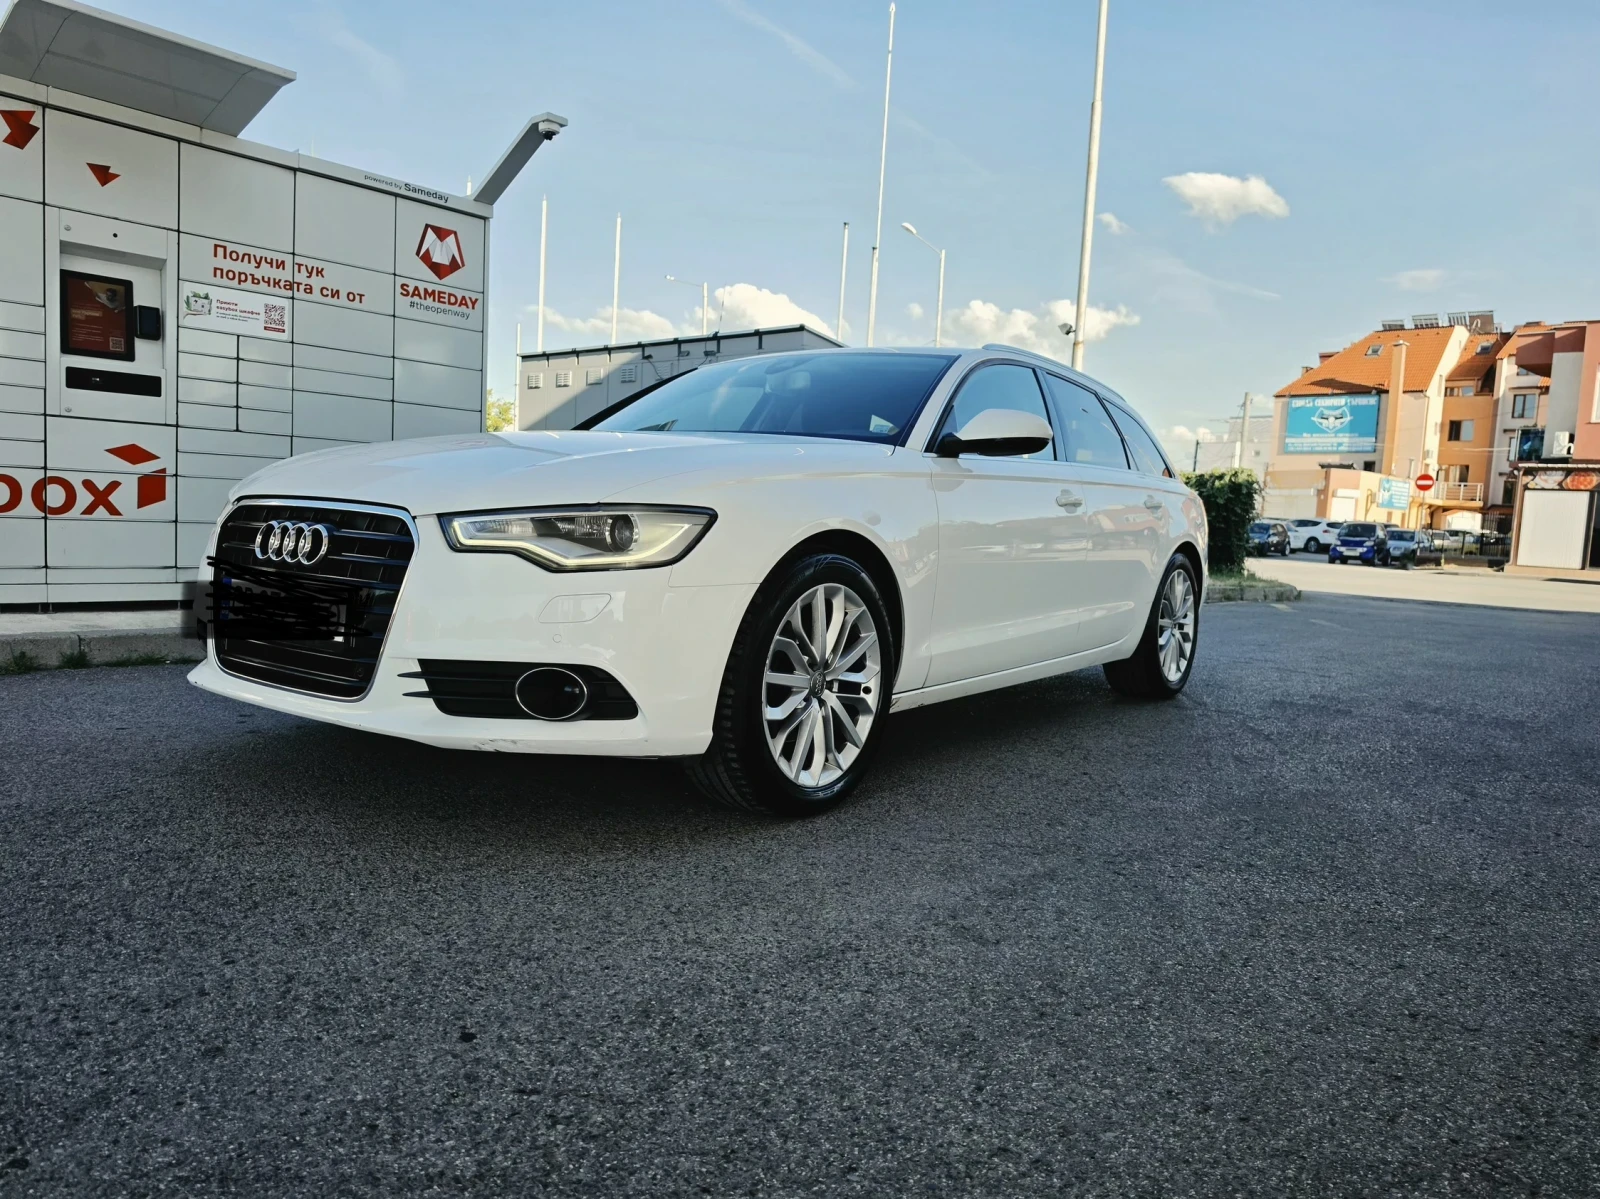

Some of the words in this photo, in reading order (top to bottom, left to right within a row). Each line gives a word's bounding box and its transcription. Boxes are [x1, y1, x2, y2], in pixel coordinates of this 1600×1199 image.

[364, 174, 393, 187] powered
[393, 181, 402, 190] by
[404, 183, 449, 203] Sameday
[213, 243, 286, 270] Получи
[295, 261, 325, 279] тук
[213, 266, 314, 296] поръчката
[320, 285, 341, 301] си
[346, 291, 365, 304] от
[400, 283, 479, 310] SAMEDAY
[409, 300, 471, 320] #theopenway
